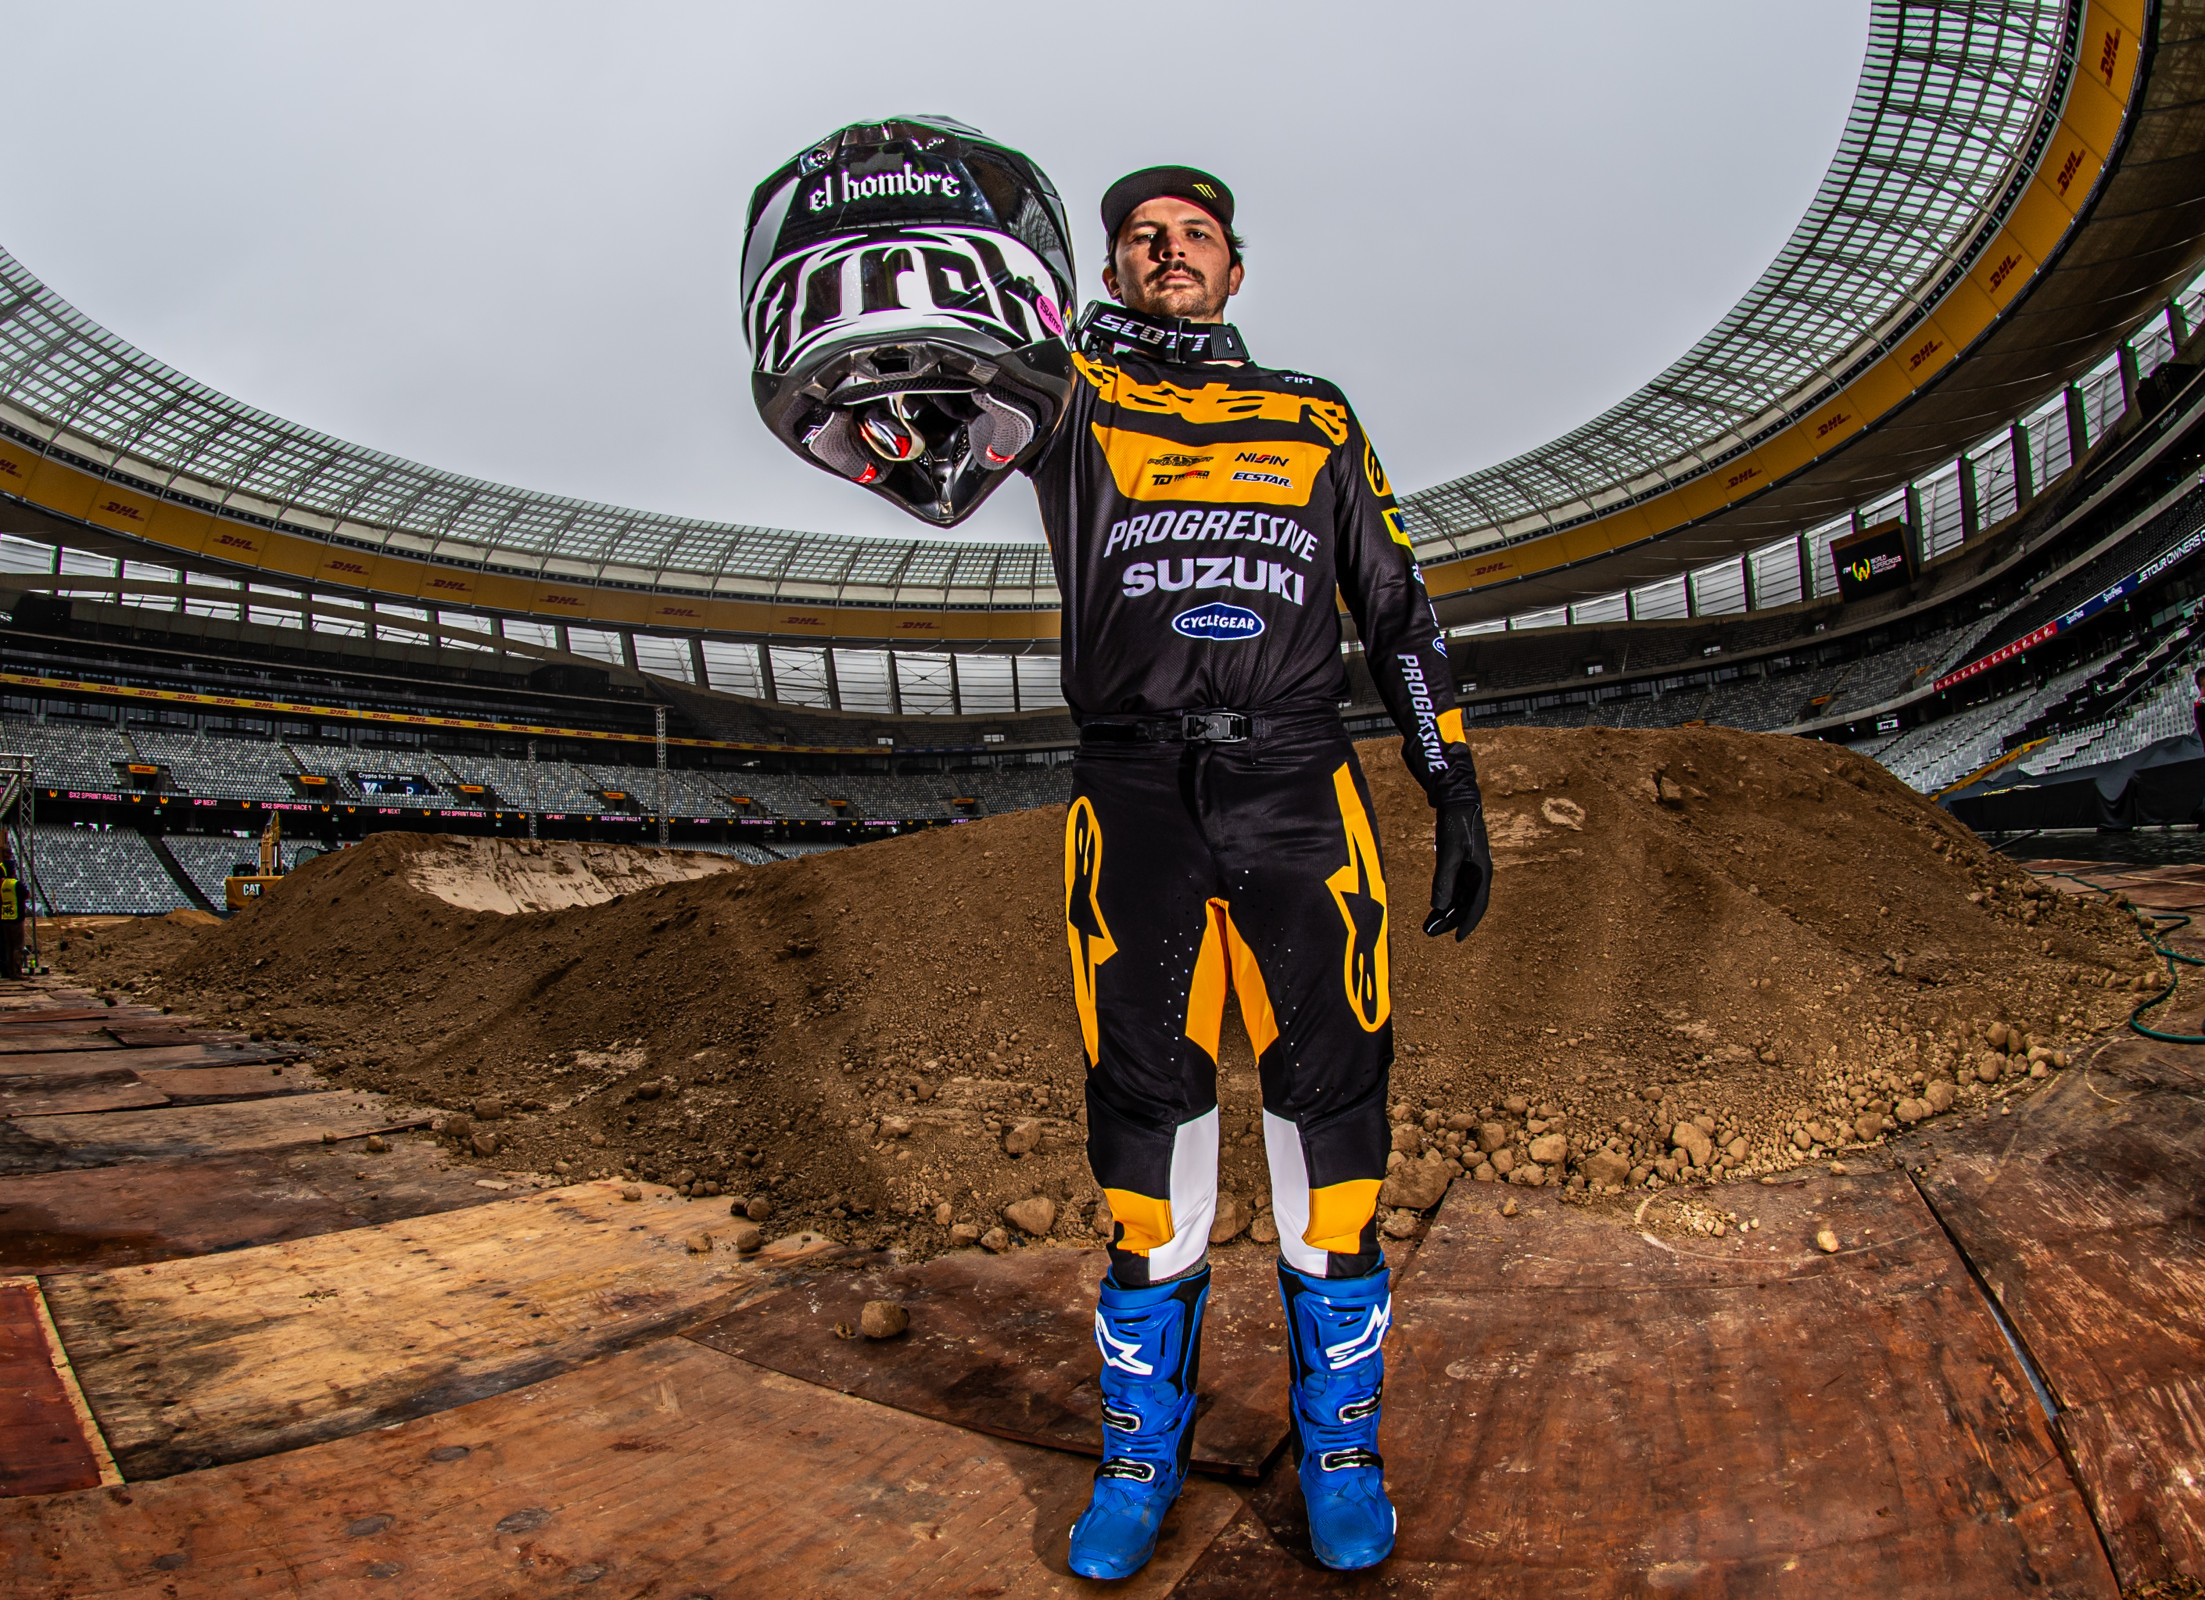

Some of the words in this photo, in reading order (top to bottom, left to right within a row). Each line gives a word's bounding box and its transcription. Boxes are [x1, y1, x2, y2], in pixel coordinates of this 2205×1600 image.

[2101, 30, 2120, 85] DHL
[808, 175, 833, 212] el
[841, 161, 960, 204] hombre
[2058, 150, 2085, 196] DHL
[1990, 255, 2021, 293] DHL
[1093, 313, 1211, 352] SCOTT
[1910, 341, 1942, 371] DHL
[1816, 413, 1849, 438] DHL
[1234, 452, 1290, 467] NISSIN
[1152, 474, 1174, 486] TD
[1231, 472, 1292, 487] ECSTAR
[1103, 509, 1319, 563] PROGRESSIVE
[2166, 534, 2202, 564] OWNERS
[1122, 555, 1305, 606] SUZUKI
[358, 772, 377, 780] Crypto
[387, 774, 413, 782] Evyone
[243, 883, 260, 896] CAT
